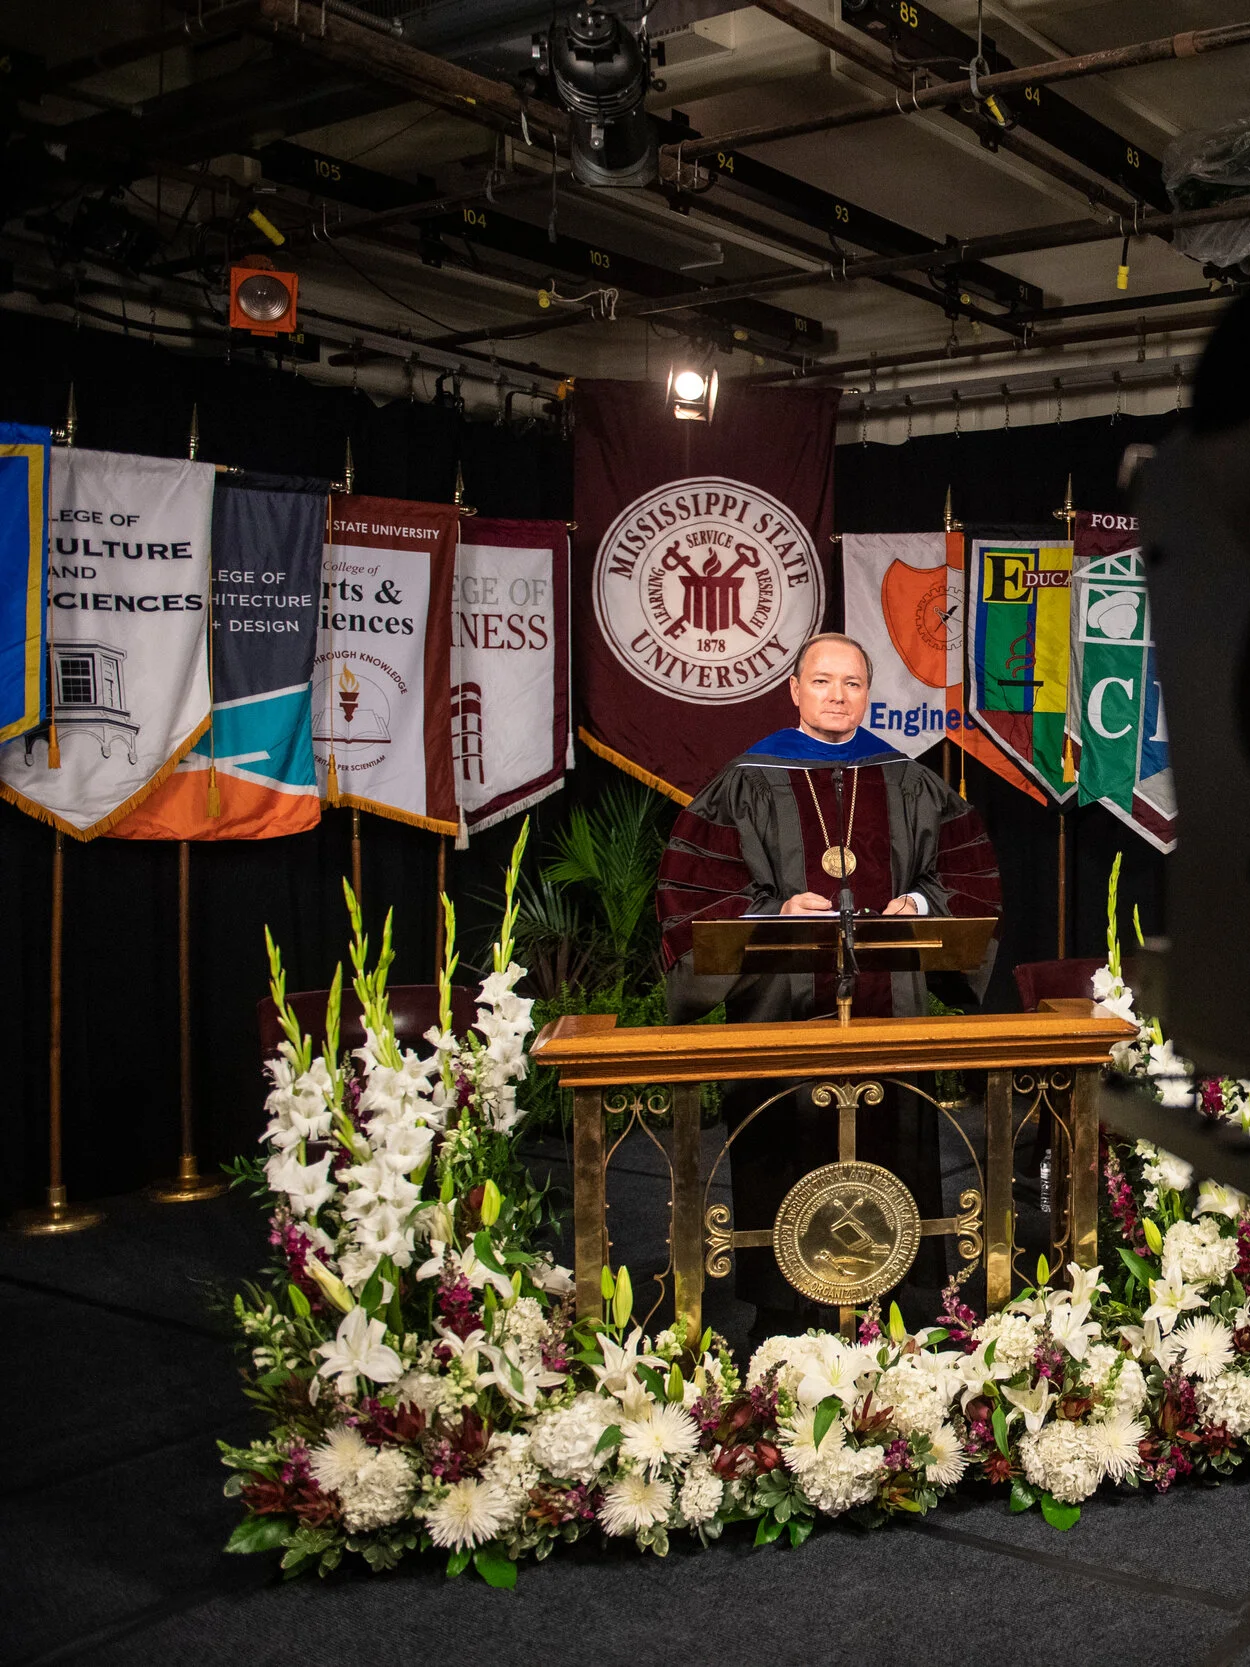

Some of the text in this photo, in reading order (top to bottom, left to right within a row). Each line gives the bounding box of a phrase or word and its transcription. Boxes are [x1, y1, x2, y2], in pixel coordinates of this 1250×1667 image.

[900, 2, 919, 29] 85
[1024, 86, 1041, 107] 84
[717, 151, 735, 174] 94
[1126, 147, 1140, 168] 83
[314, 158, 341, 181] 105
[463, 208, 487, 228] 104
[834, 204, 850, 223] 93
[589, 249, 611, 269] 103
[110, 513, 140, 527] OF
[333, 519, 368, 534] STATE
[371, 524, 440, 540] UNIVERSITY
[1091, 513, 1140, 531] FORE
[48, 537, 193, 560] ULTURE
[608, 492, 809, 588] MISSISSIPPI STATE
[685, 530, 734, 549] SERVICE
[261, 572, 286, 584] OF
[323, 560, 380, 577] College of
[321, 578, 403, 605] rts &
[509, 578, 547, 606] OF
[648, 567, 672, 626] LEARNING
[749, 568, 773, 630] RESEARCH
[229, 619, 300, 632] DESIGN
[320, 604, 414, 635] iences
[696, 638, 726, 653] 1878
[631, 629, 789, 689] UNIVERSITY
[359, 652, 408, 695] KNOWLEDGE
[1087, 676, 1134, 740] C
[351, 754, 386, 771] SCIENTIAM
[809, 1281, 863, 1299] ORGANIZED
